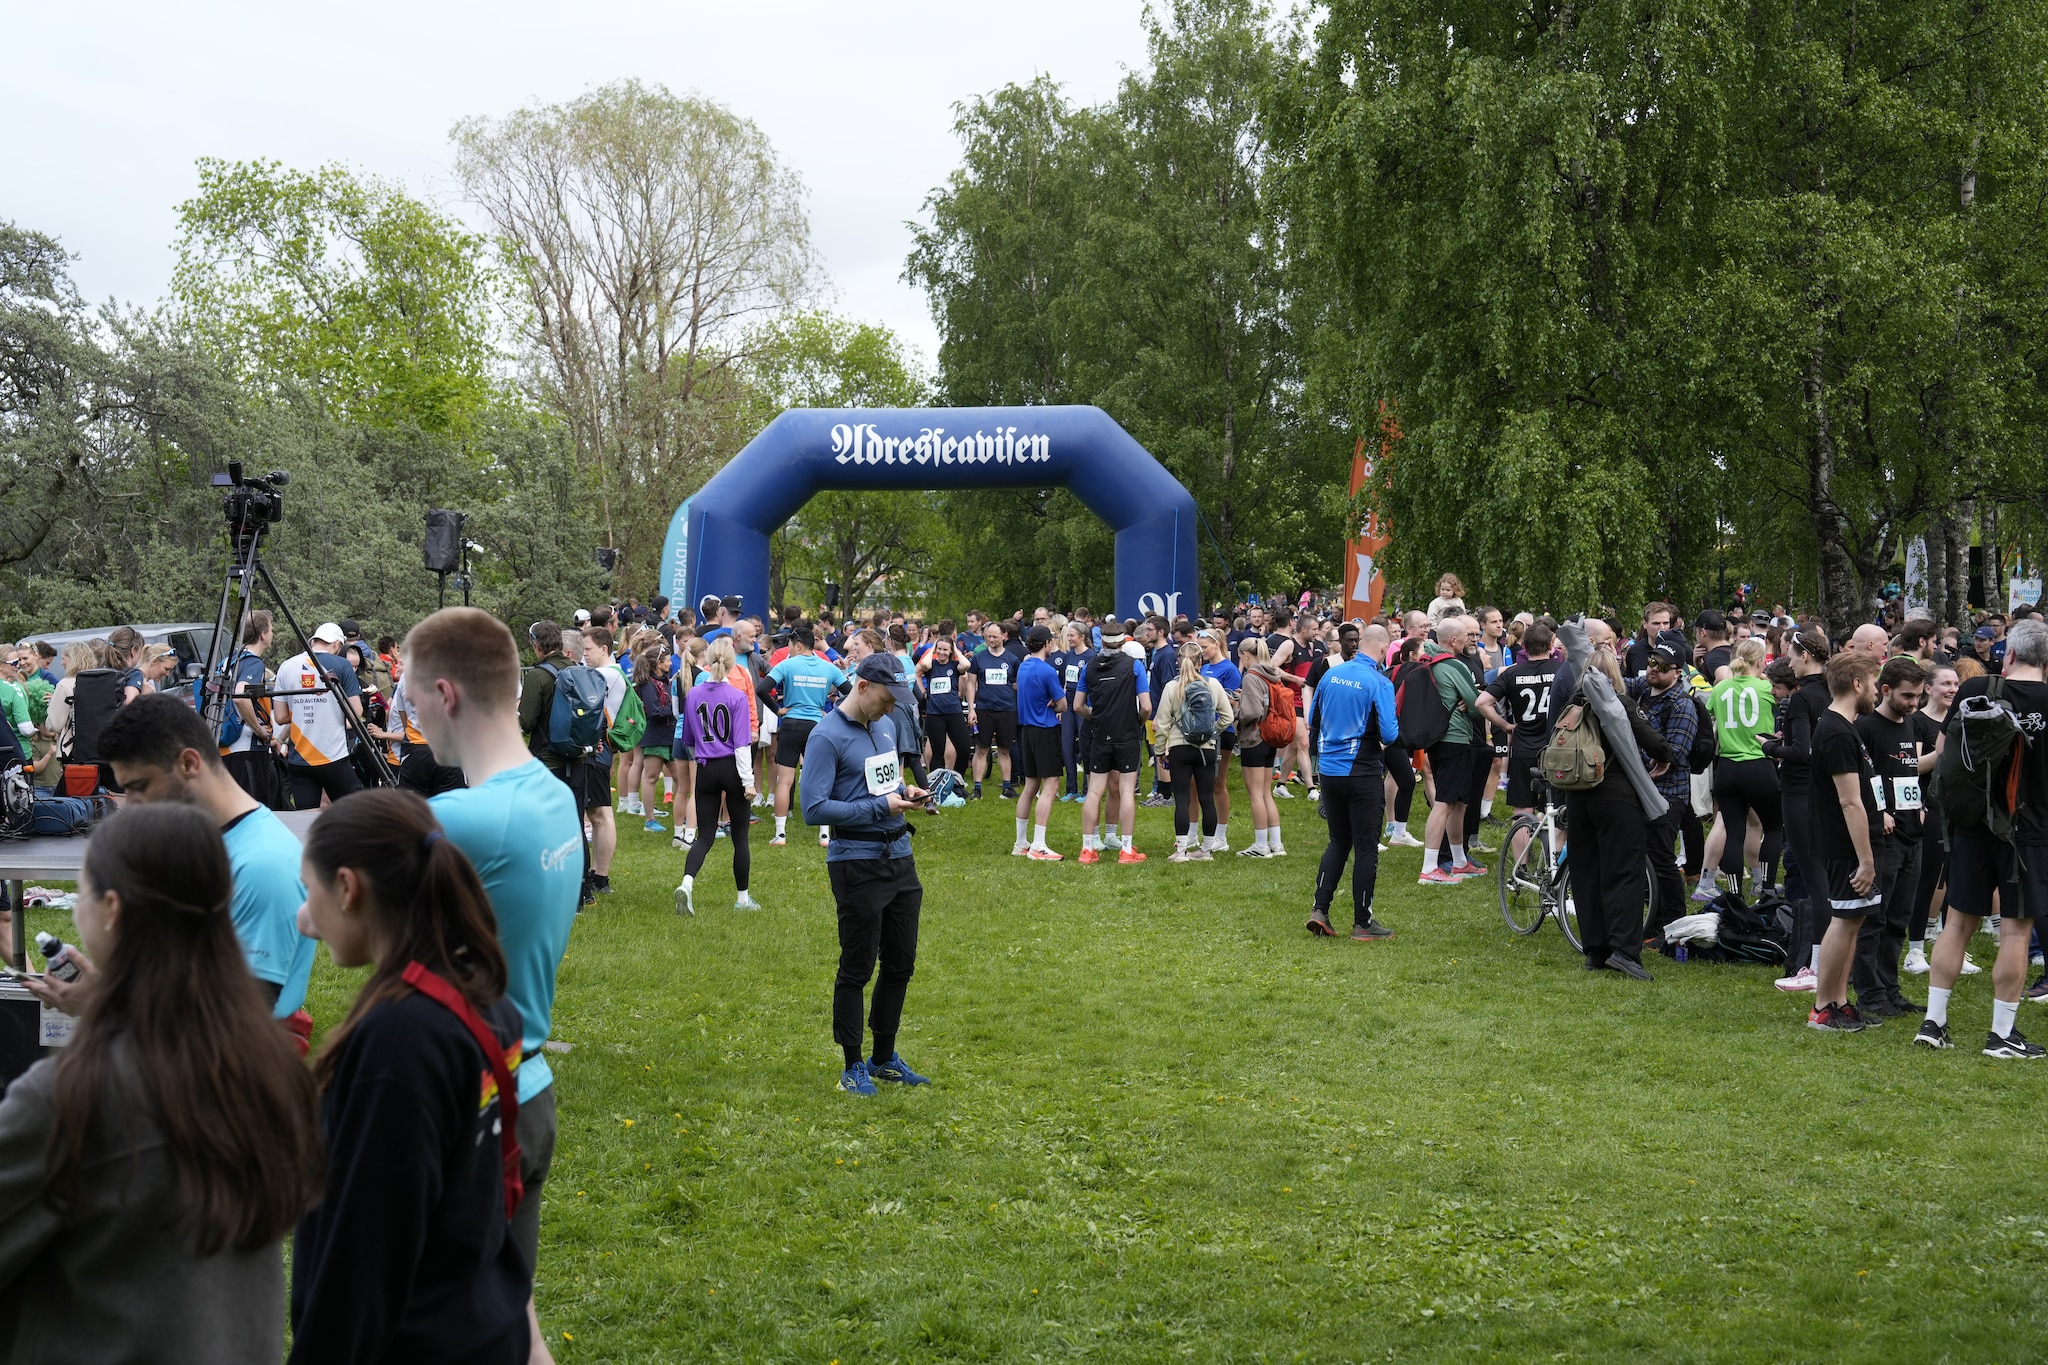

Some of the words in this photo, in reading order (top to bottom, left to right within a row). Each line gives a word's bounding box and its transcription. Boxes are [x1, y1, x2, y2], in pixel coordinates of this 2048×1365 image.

[831, 423, 1052, 468] Adresseavisen
[1330, 676, 1353, 688] BUVIK
[1354, 682, 1363, 690] IL
[1515, 675, 1542, 685] HEIMDAL
[1519, 686, 1551, 722] 24
[1720, 686, 1759, 729] 10
[696, 702, 731, 744] 10
[875, 763, 895, 784] 598
[1903, 786, 1918, 801] 65
